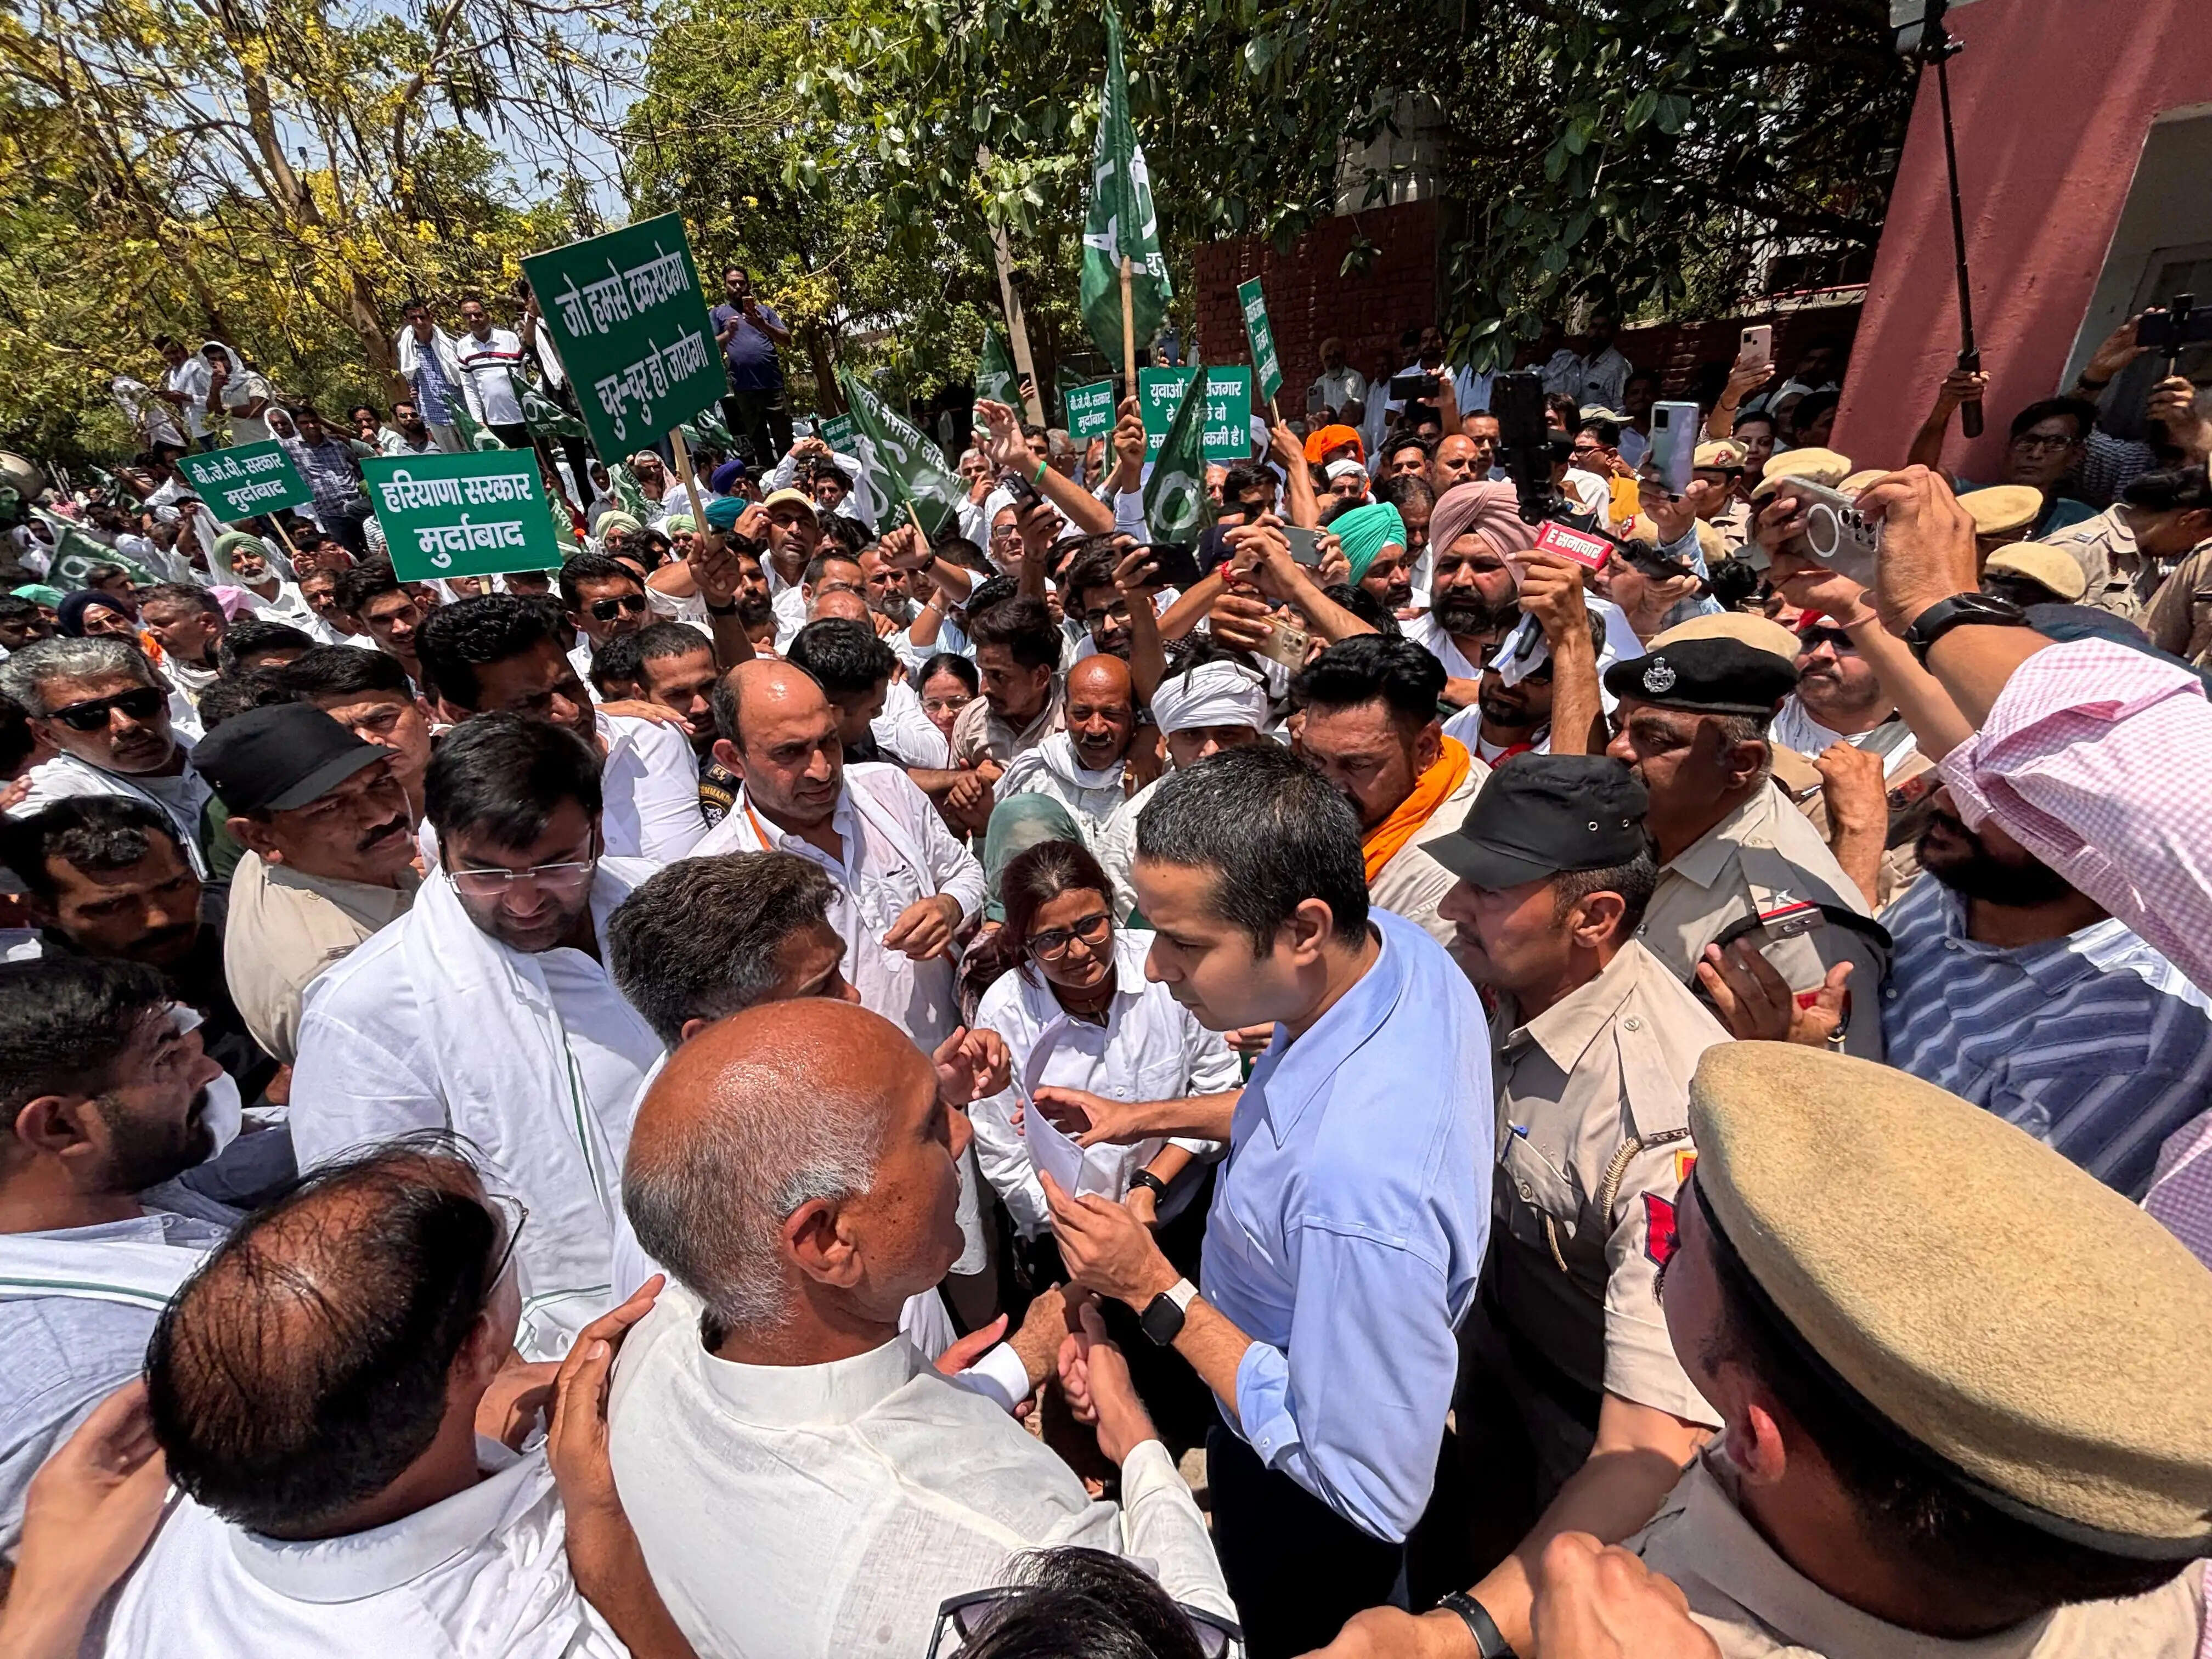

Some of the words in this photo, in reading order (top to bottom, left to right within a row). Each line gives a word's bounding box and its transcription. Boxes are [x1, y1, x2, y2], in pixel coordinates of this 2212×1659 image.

[555, 272, 592, 337] जो
[582, 257, 633, 334] हमसे
[645, 338, 669, 397] हो
[663, 324, 709, 382] जायेगा
[192, 456, 247, 484] बी.जे.पी.
[241, 452, 285, 474] सरकार
[222, 479, 287, 512] मुर्दाबाद
[379, 469, 464, 513] हरियाणा
[460, 473, 533, 505] सरकार
[414, 513, 526, 568] मुर्दाबाद
[1545, 528, 1559, 544] E
[1555, 531, 1604, 559] समाचार
[700, 786, 734, 804] OMMANDO
